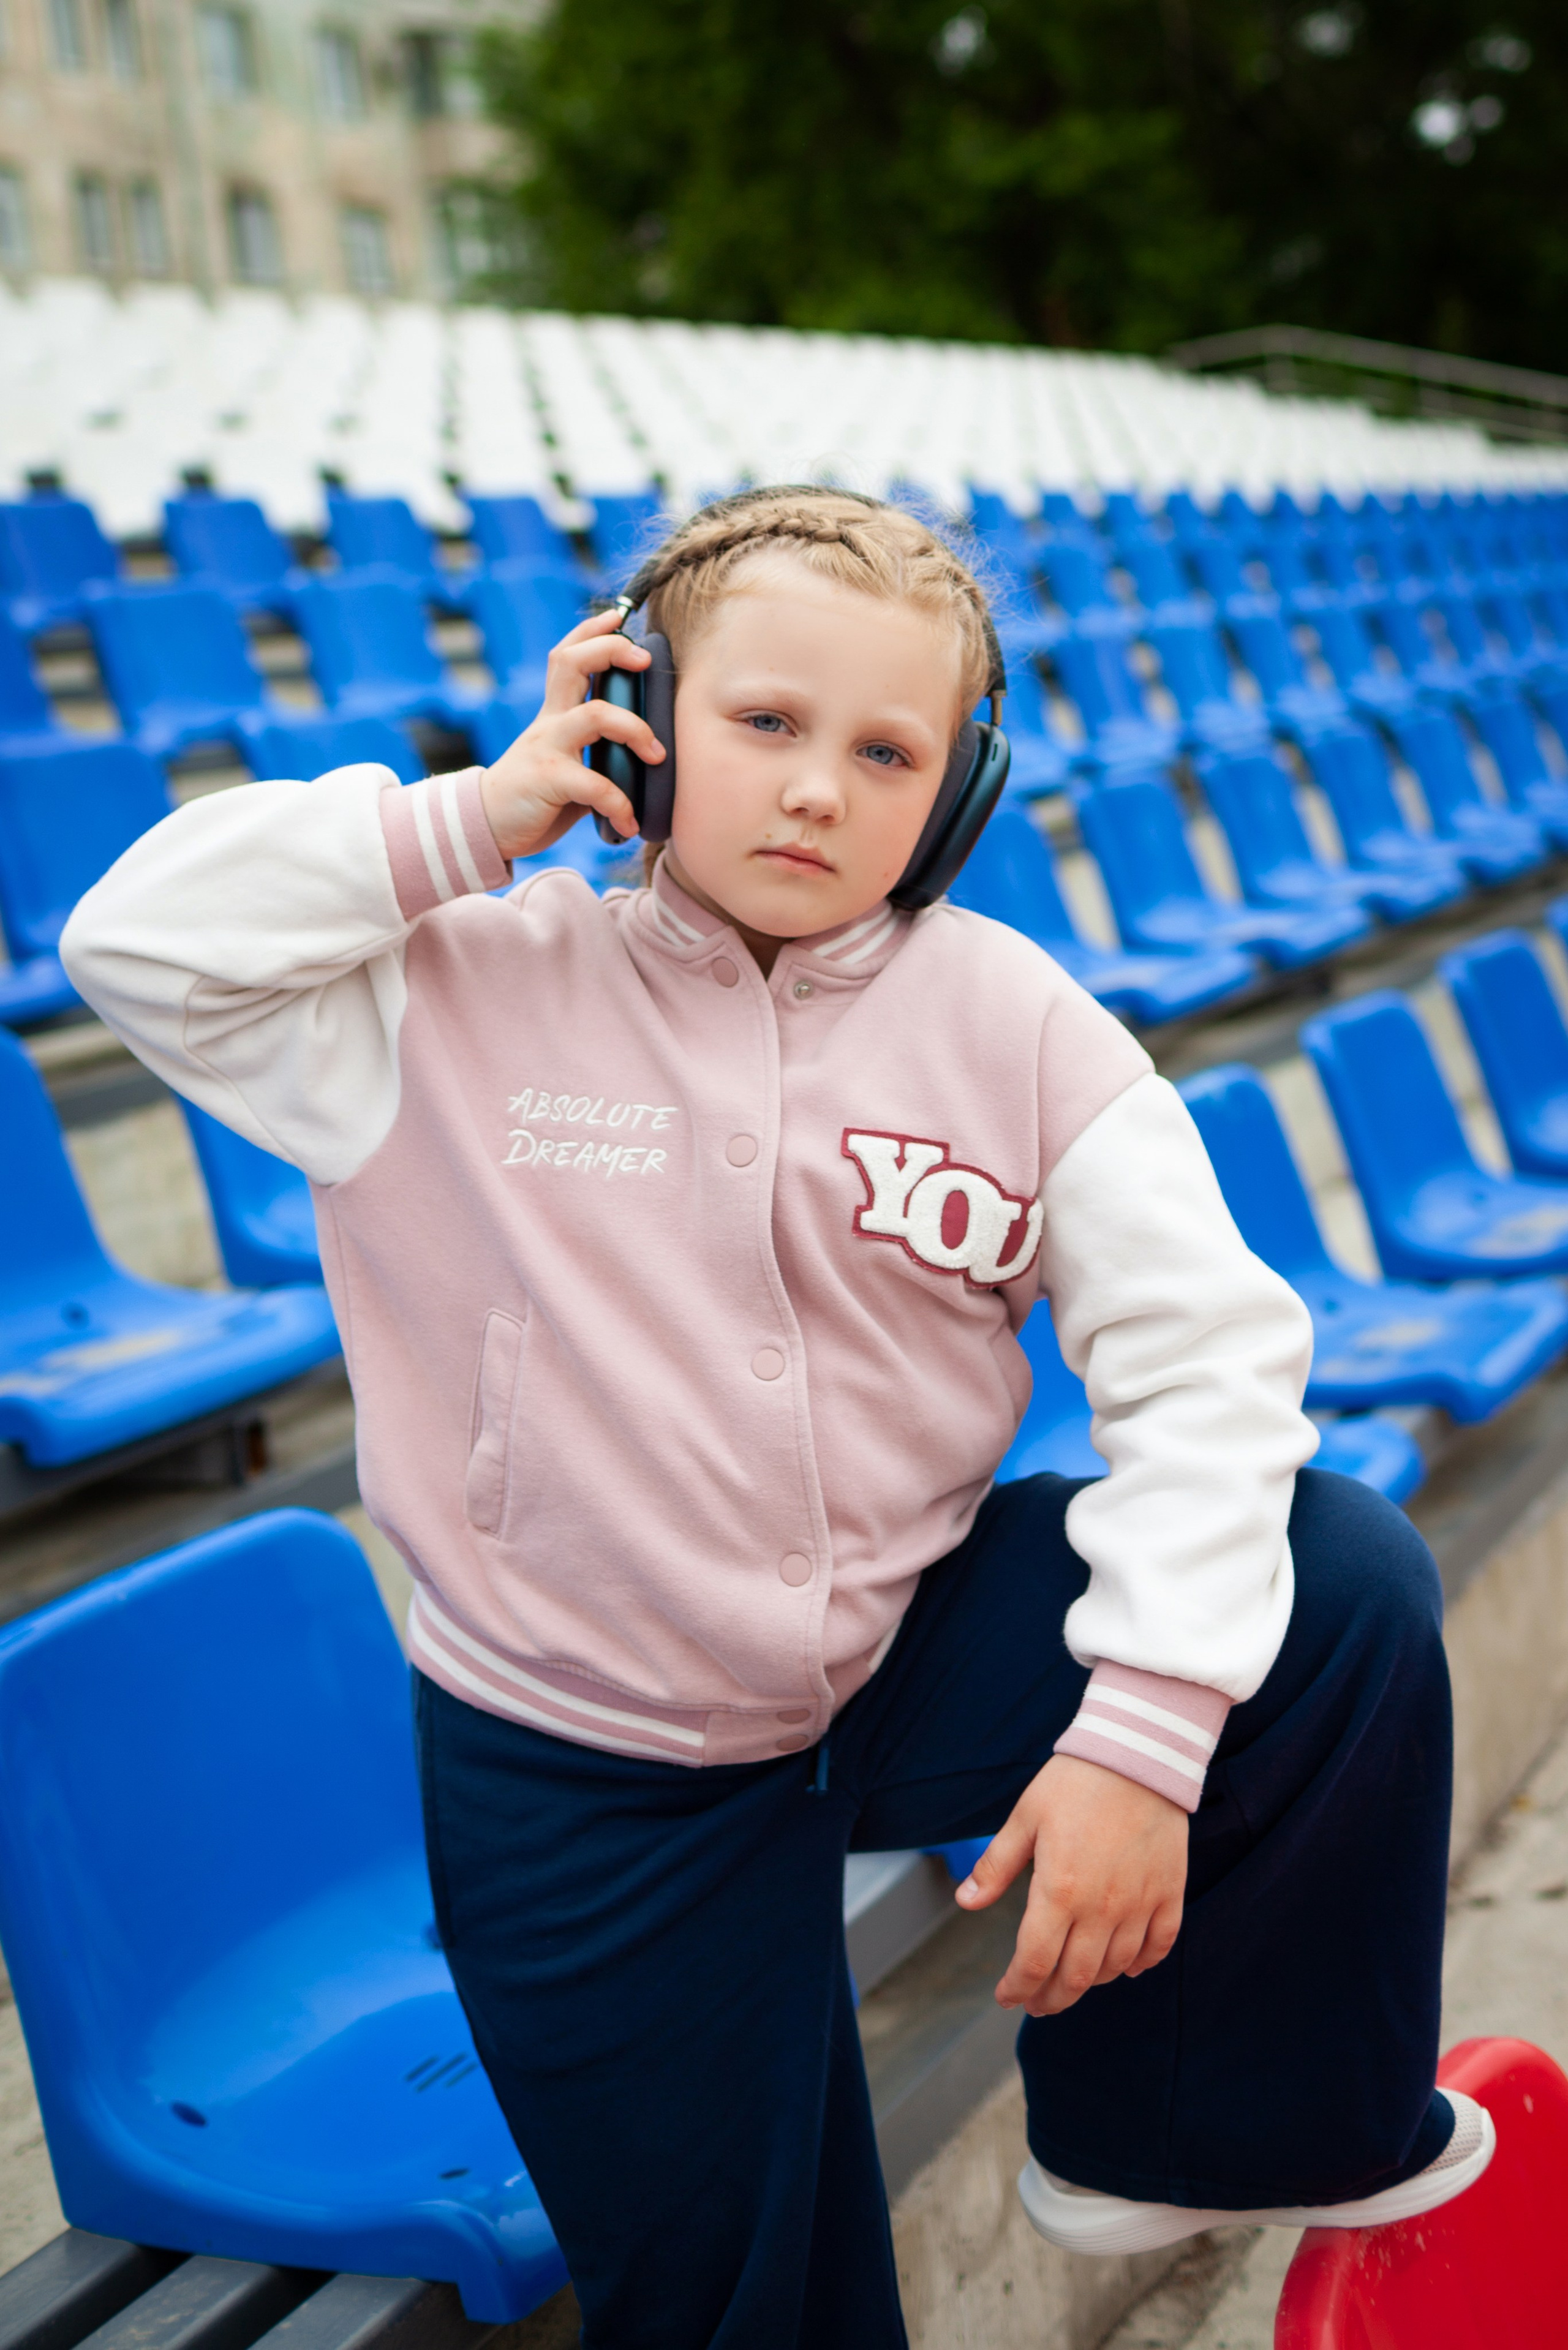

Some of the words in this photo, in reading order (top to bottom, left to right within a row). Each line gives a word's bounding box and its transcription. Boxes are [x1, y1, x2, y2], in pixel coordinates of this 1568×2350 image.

[508, 1088, 679, 1130] ABSOLUTE
[500, 1129, 668, 1178] DREAMER
[843, 1129, 1044, 1287] YOU
